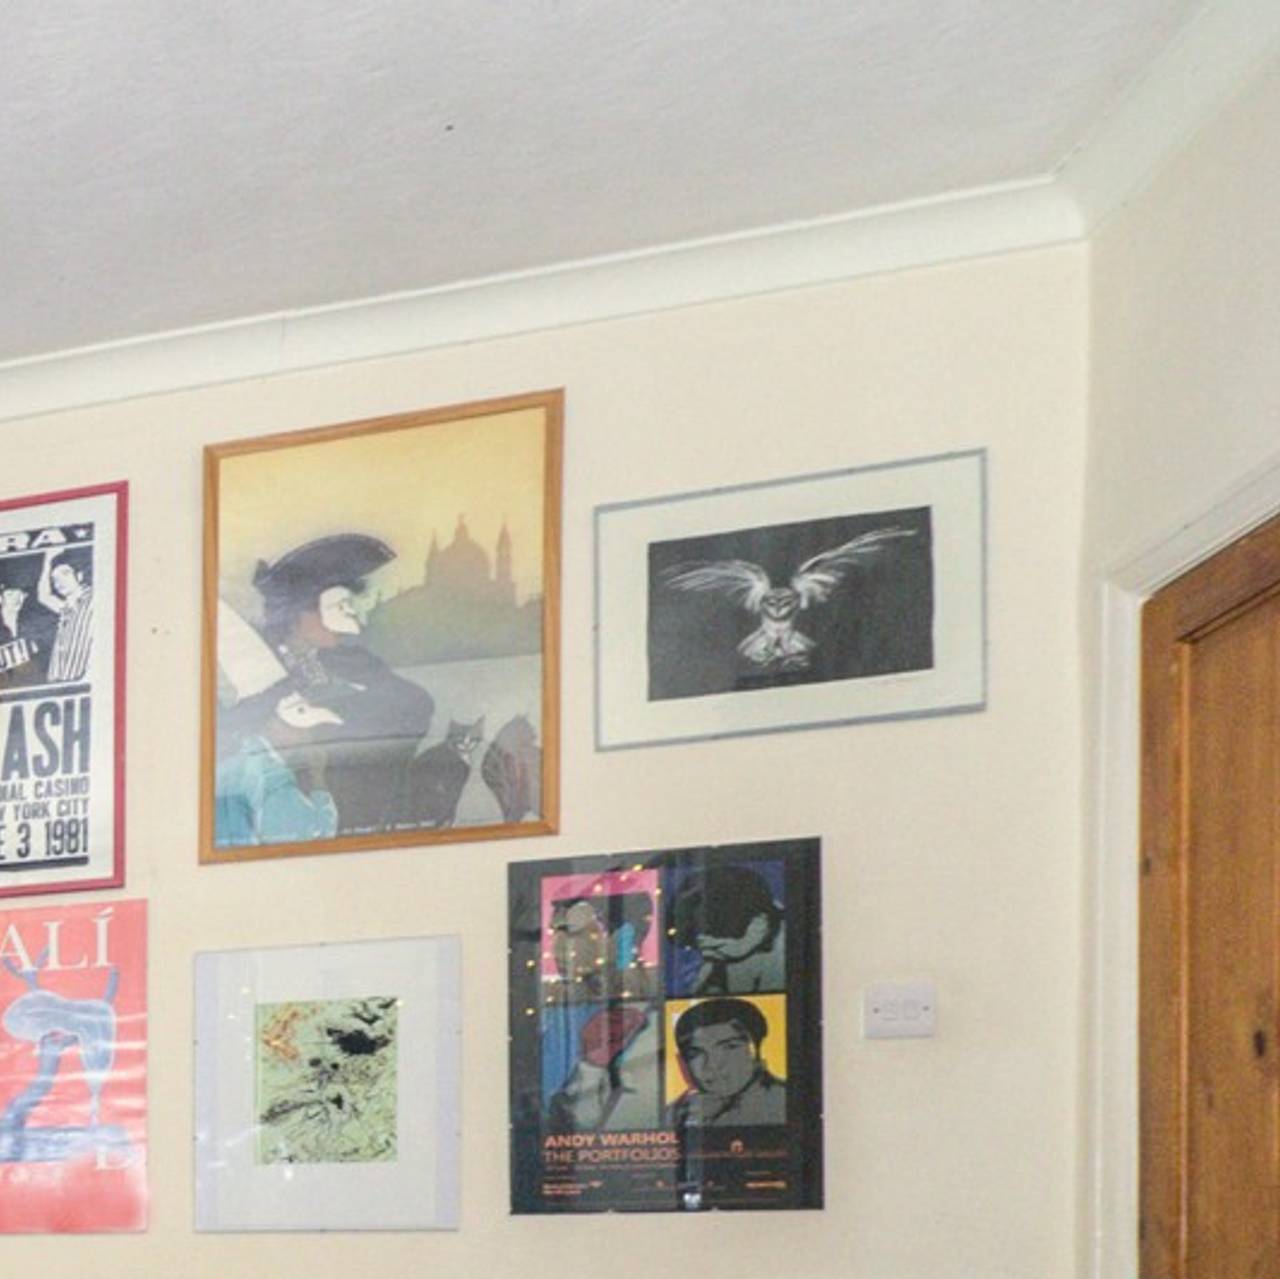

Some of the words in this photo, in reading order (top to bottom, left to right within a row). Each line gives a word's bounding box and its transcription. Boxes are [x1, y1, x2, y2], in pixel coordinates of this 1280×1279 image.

[34, 776, 89, 800] CASINO
[14, 802, 50, 821] YORK
[56, 798, 89, 817] CITY
[17, 822, 31, 857] 3
[45, 817, 89, 856] 1981
[544, 1133, 597, 1148] ANDY
[600, 1131, 680, 1147] WARHOL
[543, 1149, 574, 1163] THE
[577, 1147, 681, 1162] PORTFOLIOS
